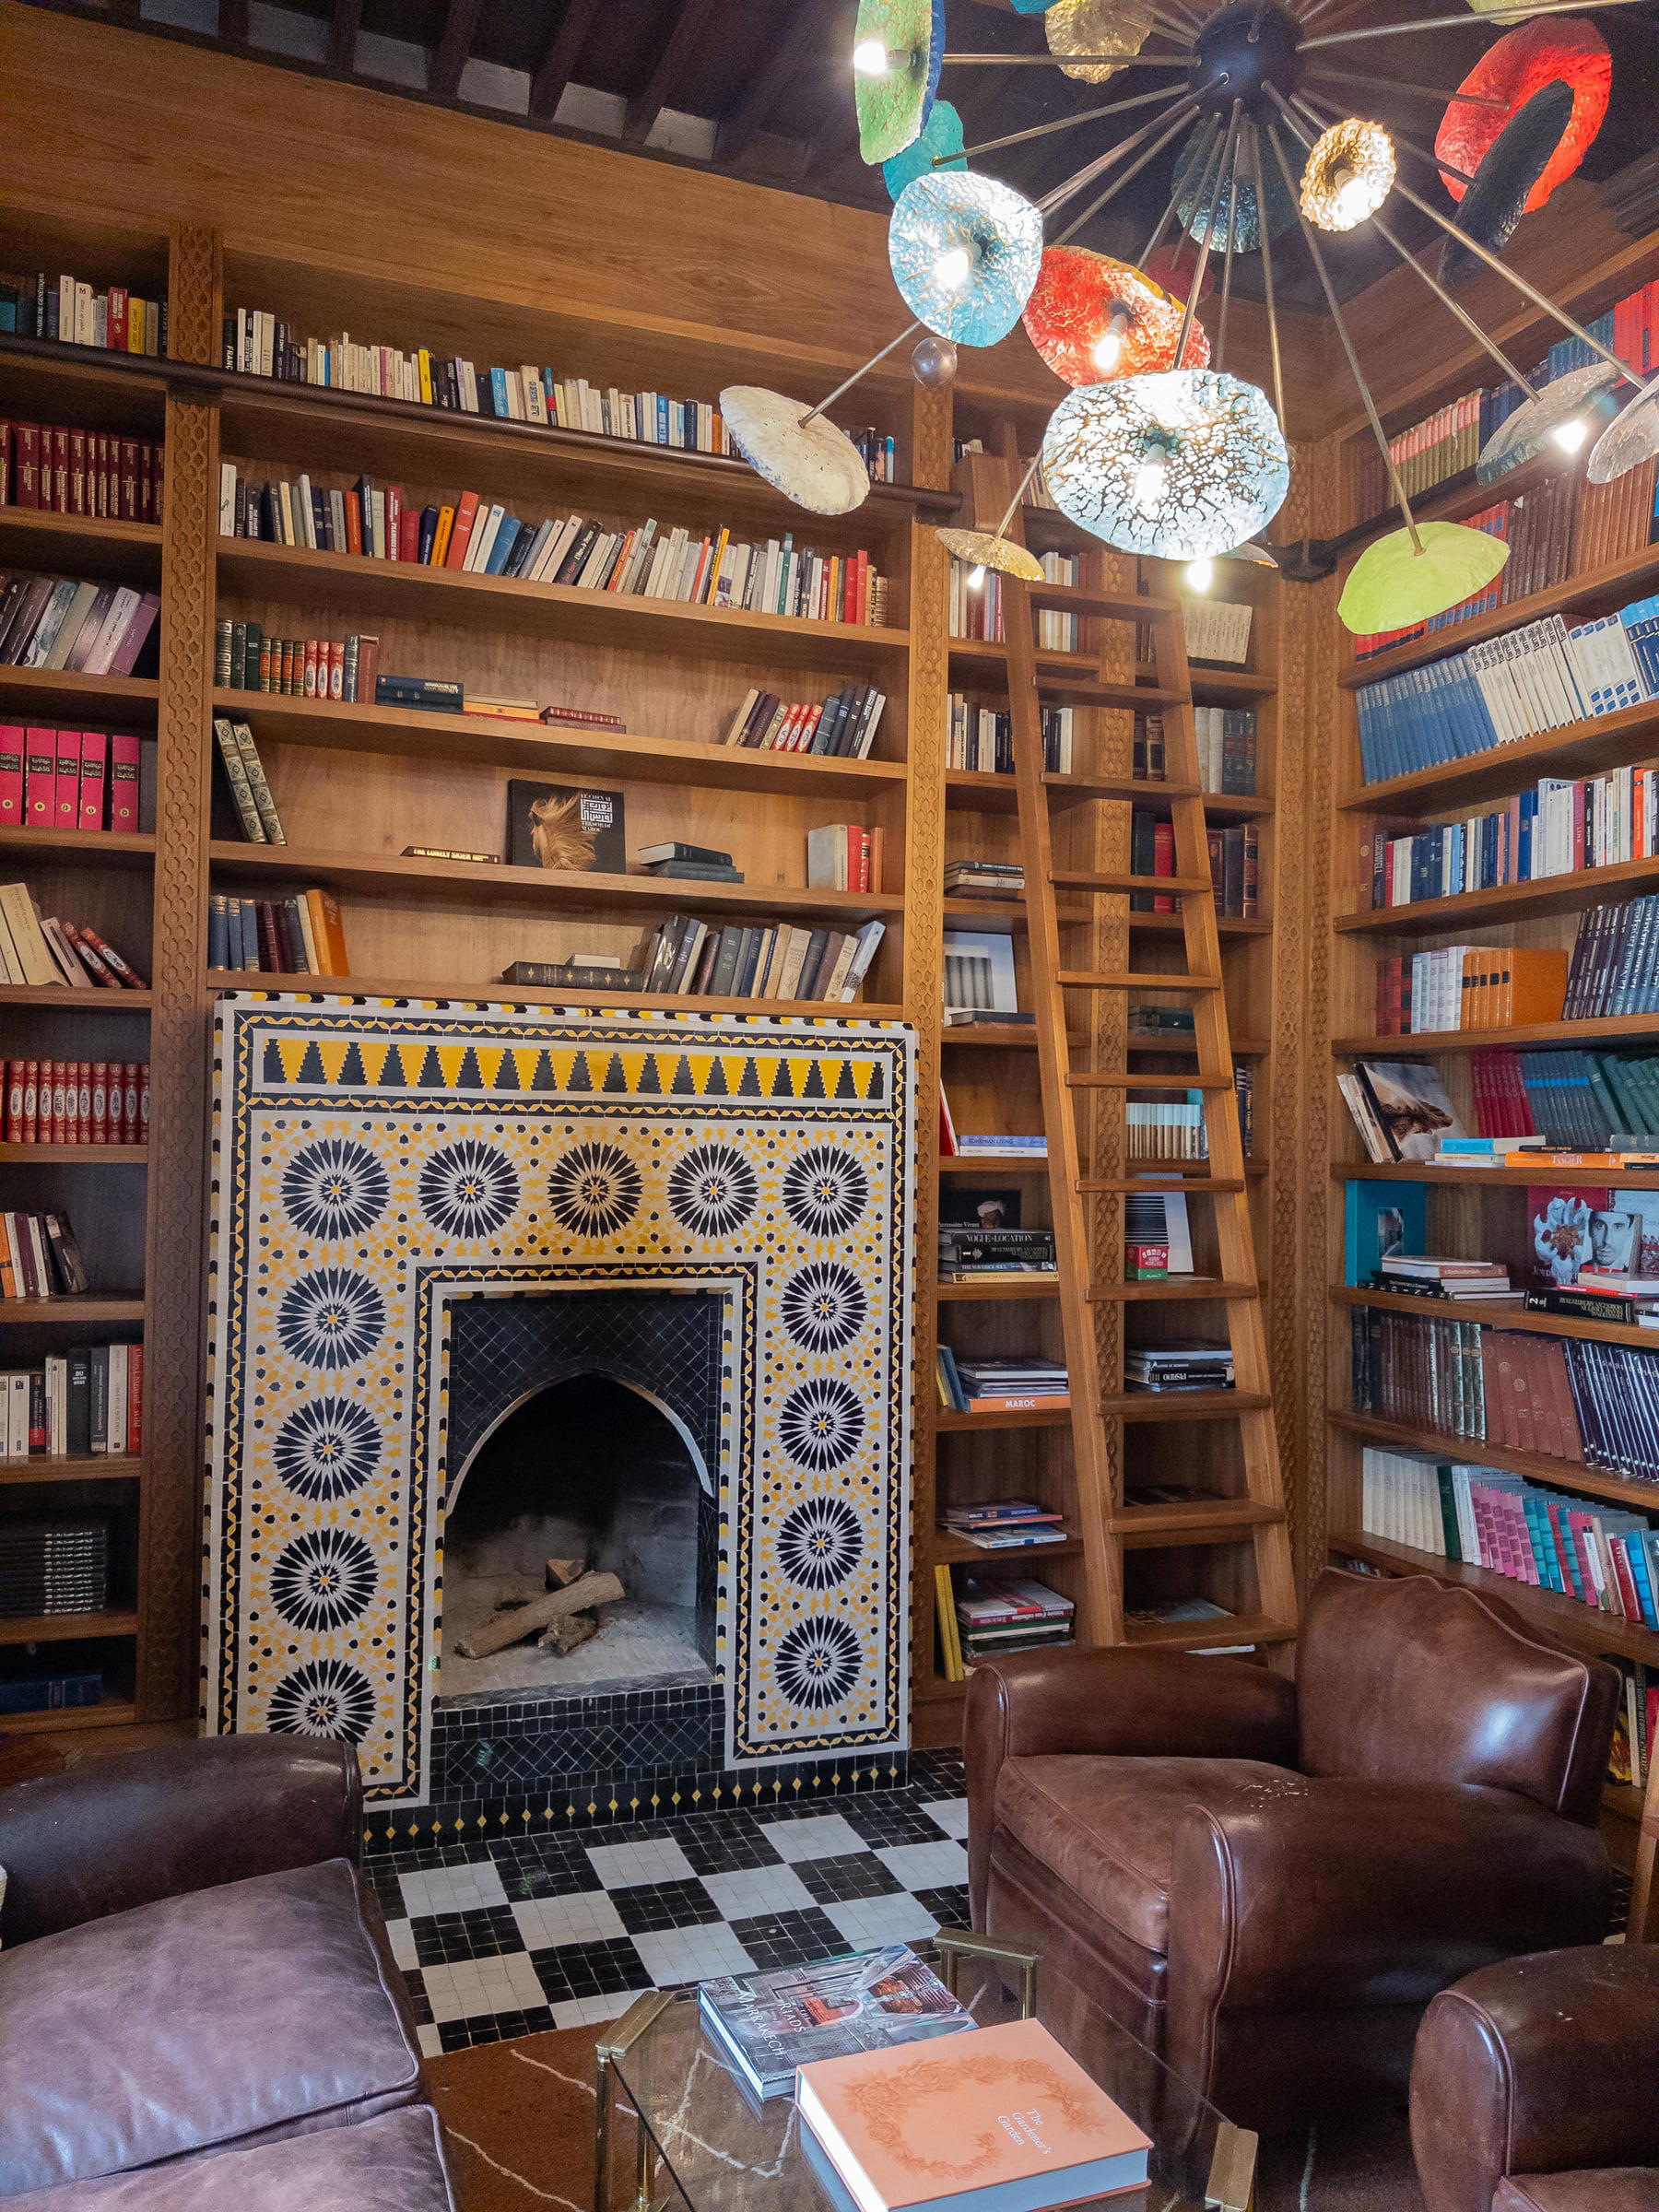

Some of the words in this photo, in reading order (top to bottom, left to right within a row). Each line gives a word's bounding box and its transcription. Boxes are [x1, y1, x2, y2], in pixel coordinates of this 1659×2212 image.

[1005, 1399, 1035, 1408] MAROC
[735, 1991, 788, 2057] MARRAKECH
[778, 2002, 806, 2033] RIADS
[997, 2115, 1025, 2146] Garden
[1026, 2108, 1043, 2126] The
[1013, 2112, 1053, 2155] Gardener's
